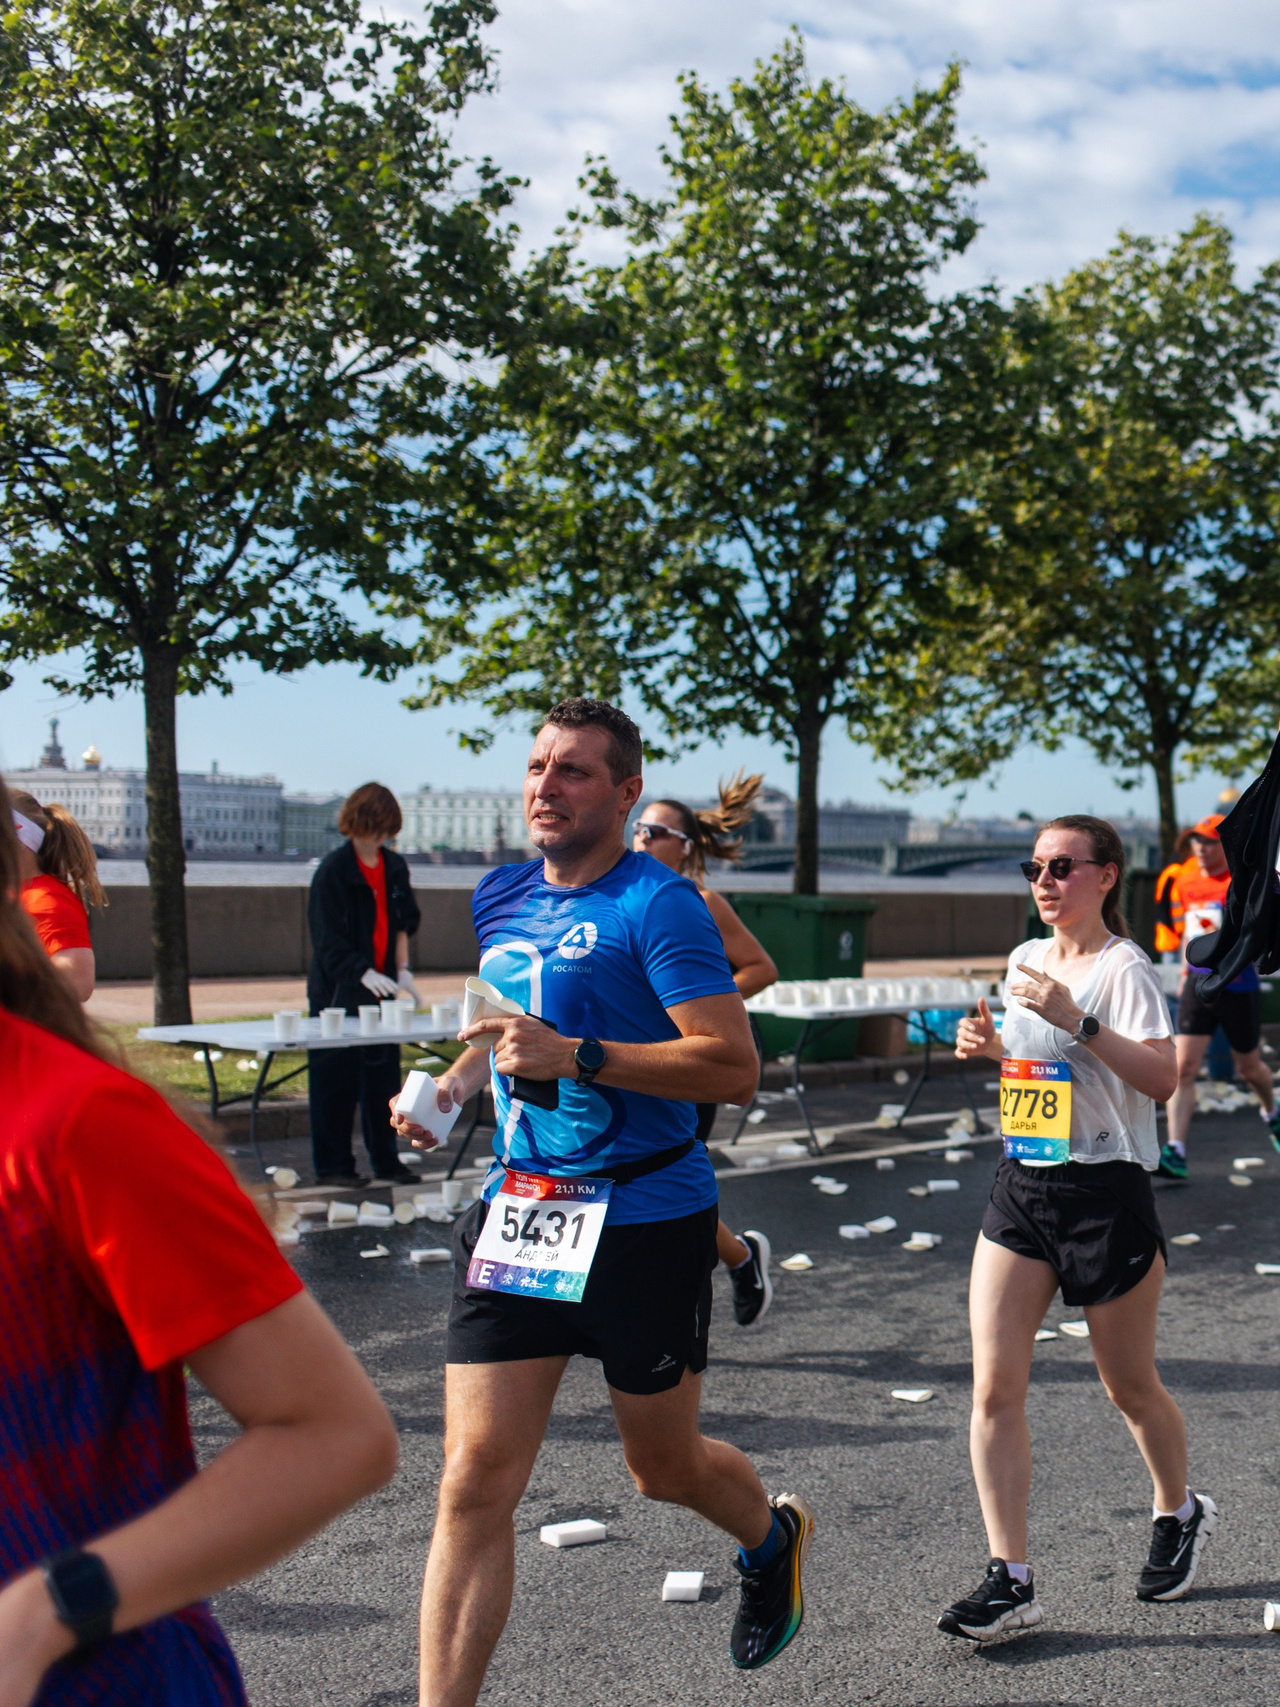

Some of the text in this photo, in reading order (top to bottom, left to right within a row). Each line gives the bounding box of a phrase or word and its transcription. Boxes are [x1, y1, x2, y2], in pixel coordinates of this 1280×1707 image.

[552, 965, 592, 974] РОСАТОМ
[1002, 1086, 1058, 1119] 2778
[1010, 1121, 1037, 1131] ДАРЬЯ
[555, 1184, 574, 1195] 21,1
[501, 1204, 586, 1250] 5431
